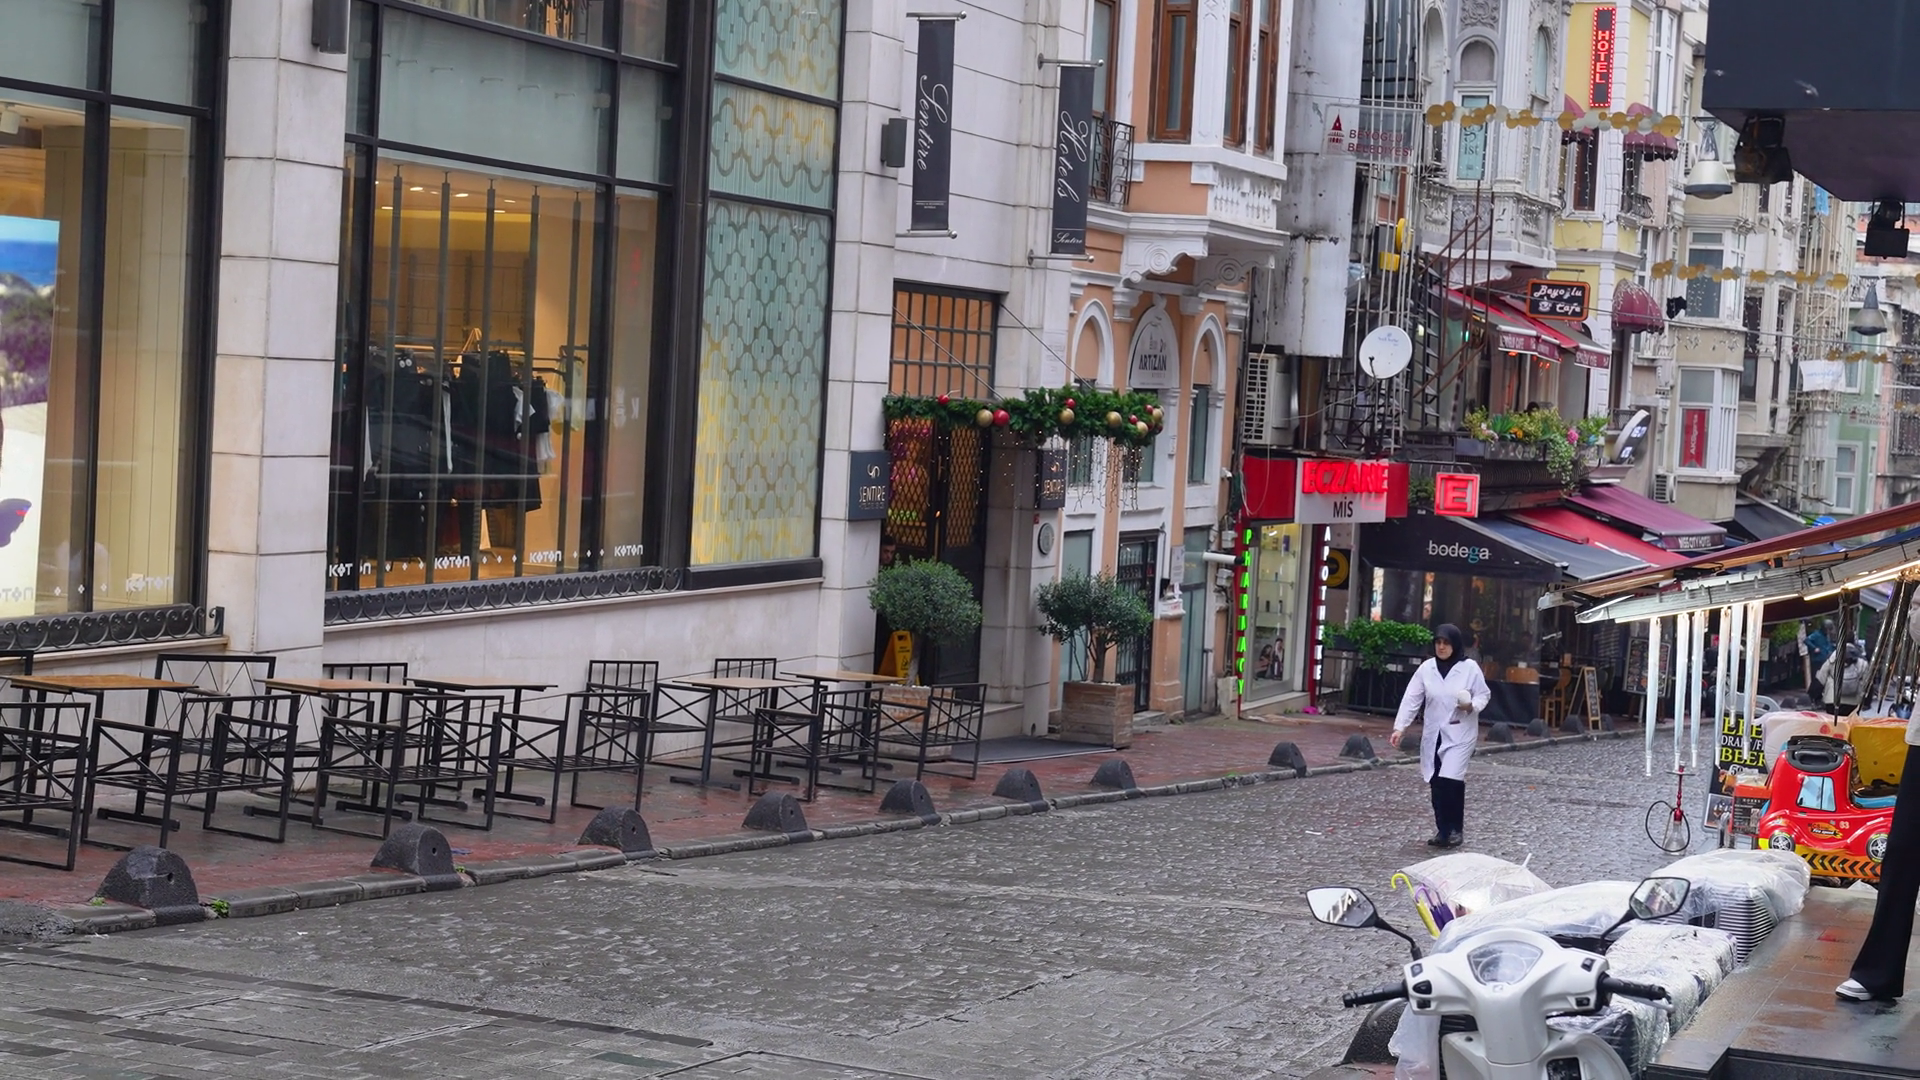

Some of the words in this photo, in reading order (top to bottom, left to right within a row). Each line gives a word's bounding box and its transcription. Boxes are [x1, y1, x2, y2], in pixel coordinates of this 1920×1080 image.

[1596, 30, 1609, 83] HOTEL
[917, 74, 949, 171] Sentire
[1057, 110, 1089, 203] Hotels
[1303, 462, 1388, 494] ECZANE
[434, 555, 470, 570] KOTON
[530, 550, 562, 563] KOTON
[1428, 540, 1489, 563] bodega
[1236, 528, 1252, 695] PHARMACY
[1313, 526, 1331, 680] APOTHEKE
